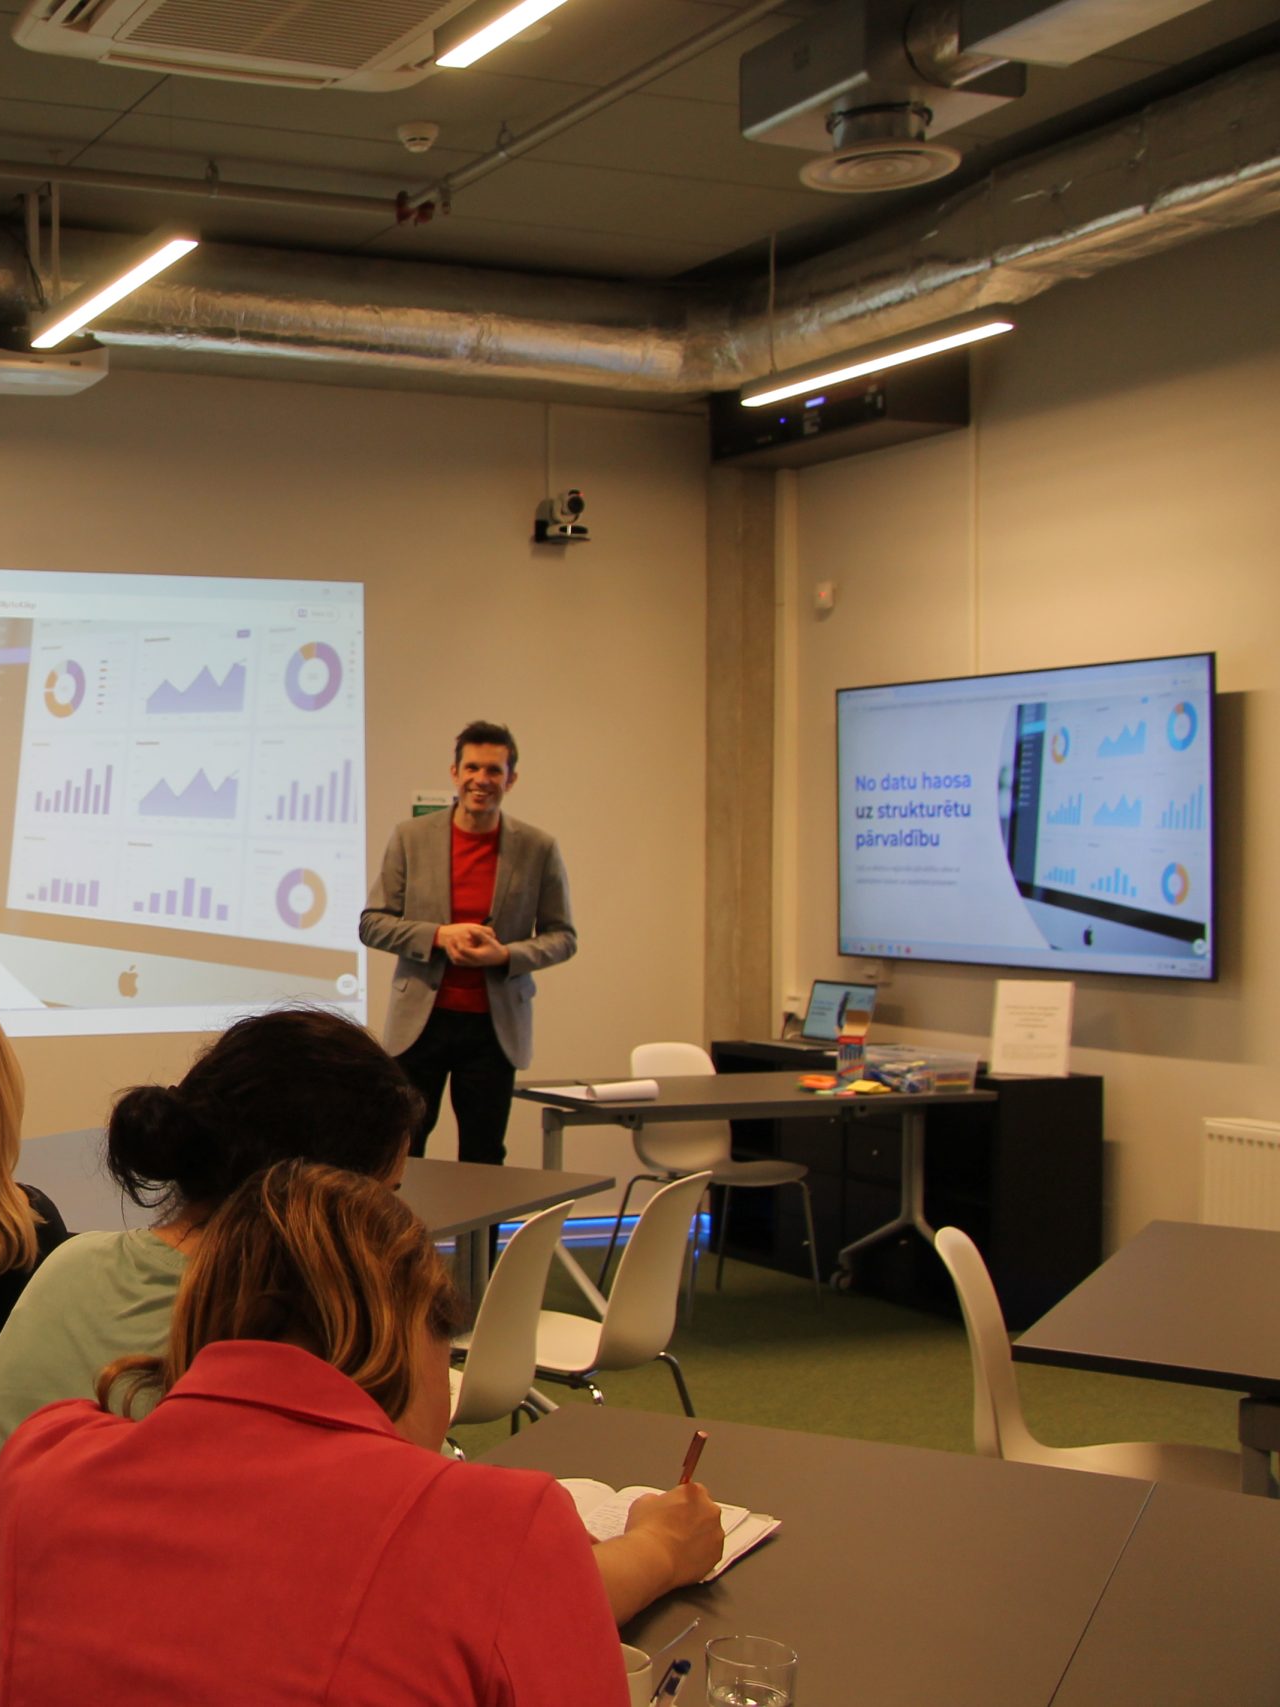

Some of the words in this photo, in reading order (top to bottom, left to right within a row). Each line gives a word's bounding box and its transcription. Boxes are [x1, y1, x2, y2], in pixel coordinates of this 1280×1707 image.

[856, 775, 877, 791] No
[881, 772, 917, 790] datu
[922, 772, 972, 789] haosa
[856, 805, 873, 819] uz
[877, 800, 971, 818] strukturētu
[856, 829, 939, 850] pārvaldību
